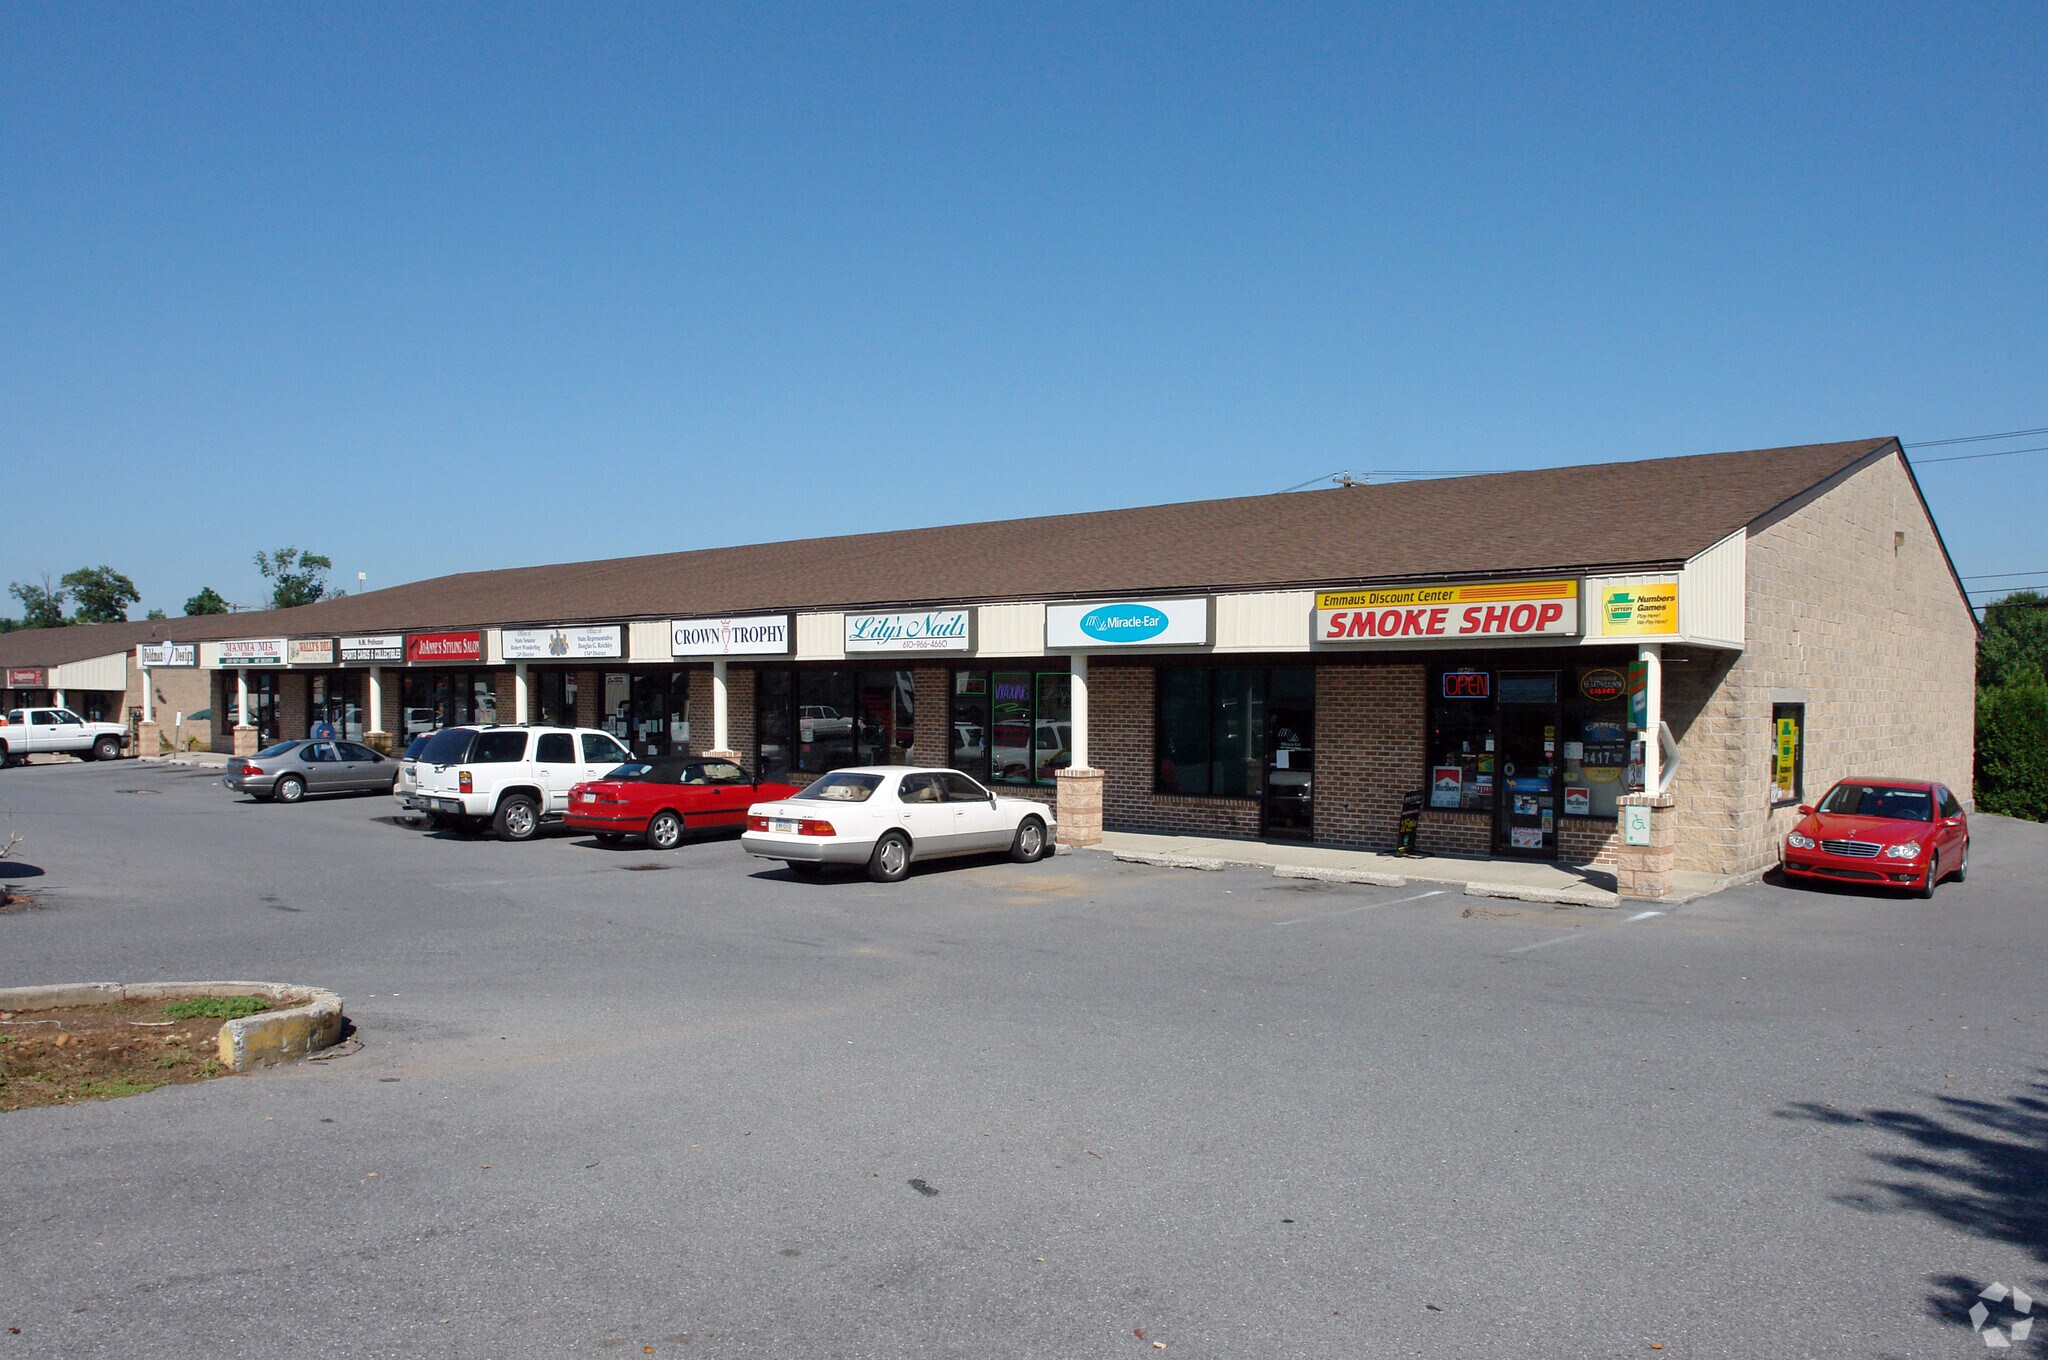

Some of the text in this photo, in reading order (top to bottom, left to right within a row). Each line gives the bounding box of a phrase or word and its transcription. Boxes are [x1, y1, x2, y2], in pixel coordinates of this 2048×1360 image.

[1324, 590, 1454, 607] Emmaus Discount Center
[1637, 595, 1675, 603] Numbers
[1637, 604, 1666, 612] Games
[849, 611, 965, 645] Lily's Nails
[1107, 616, 1160, 628] Miracle-Ear
[1327, 604, 1563, 638] SMOKE SHOP
[675, 625, 785, 645] CROWN TROPHY
[225, 641, 273, 652] MAMMA MIA
[463, 638, 480, 653] SALON
[903, 640, 947, 648] 610-966-4660
[175, 647, 193, 665] Design
[995, 684, 1030, 700] WAXING
[1446, 675, 1487, 695] OPEN
[1585, 722, 1621, 731] CAMEL
[1435, 783, 1459, 792] Marlboro
